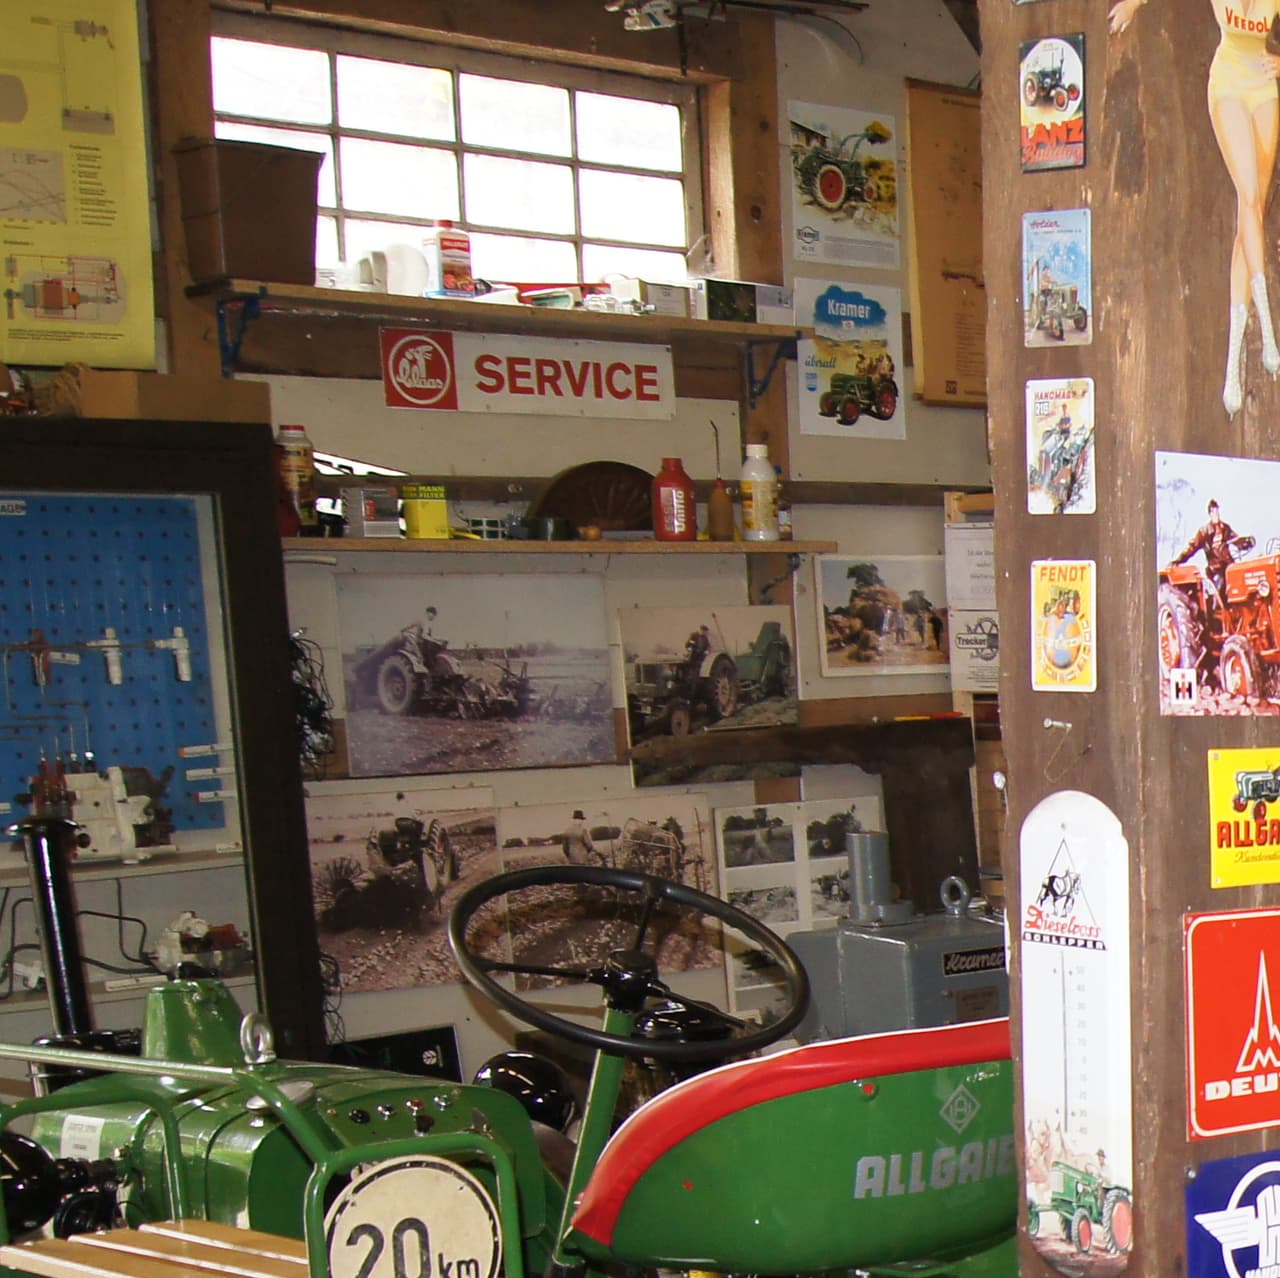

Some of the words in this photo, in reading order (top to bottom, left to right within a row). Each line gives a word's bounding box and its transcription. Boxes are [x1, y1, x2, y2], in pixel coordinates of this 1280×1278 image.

[1225, 6, 1272, 35] VEEDOL
[1021, 118, 1083, 147] LANZ
[827, 298, 871, 320] Kramer
[804, 354, 838, 370] überall
[474, 352, 660, 402] SERVICE
[1040, 566, 1087, 582] FENDT
[1024, 904, 1102, 940] Dieselross
[1022, 932, 1106, 951] SCHLEPPER
[853, 1132, 1014, 1200] ALLGAIE
